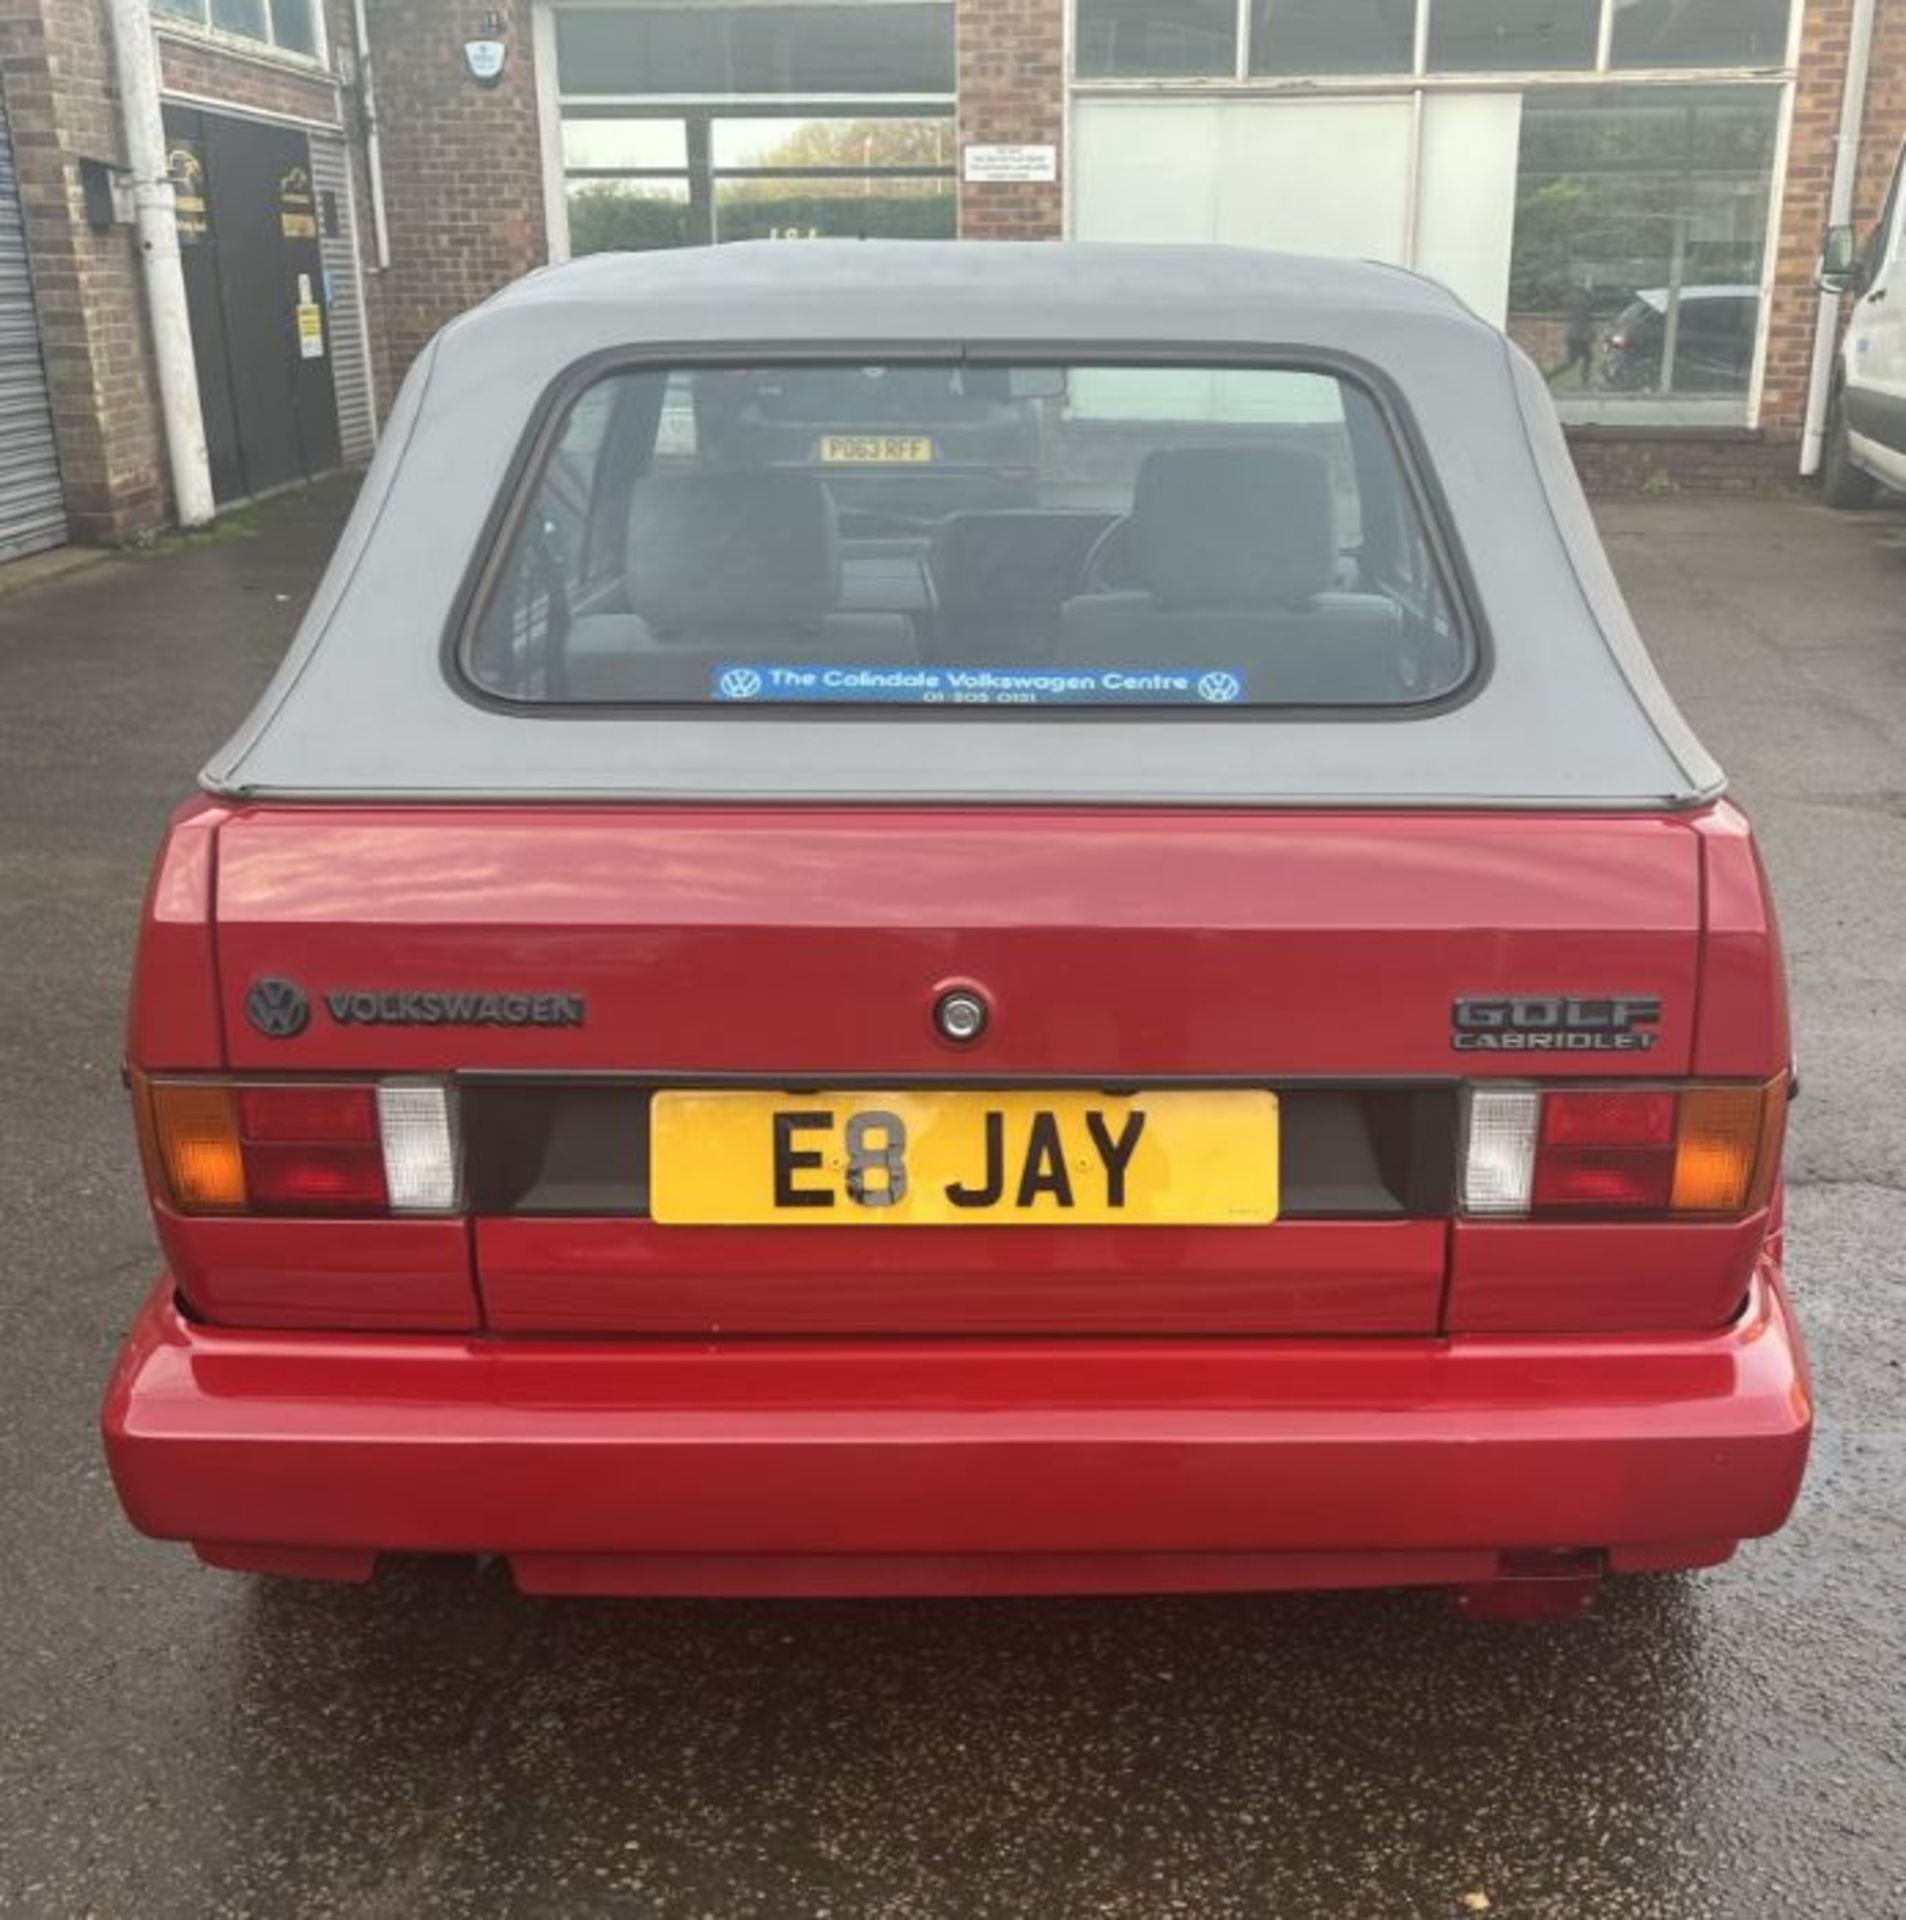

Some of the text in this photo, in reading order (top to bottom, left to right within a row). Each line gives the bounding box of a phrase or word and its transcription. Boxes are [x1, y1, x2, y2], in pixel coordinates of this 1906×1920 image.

[769, 669, 816, 687] The
[823, 670, 940, 688] Colindale
[947, 672, 1096, 692] Volkswagen
[1101, 672, 1189, 690] Centre
[324, 990, 586, 1027] VOLKSWAGEN
[1452, 996, 1661, 1031] GOLF
[1452, 1032, 1658, 1051] CABRIOLET
[771, 1110, 1147, 1208] E8 JAY
